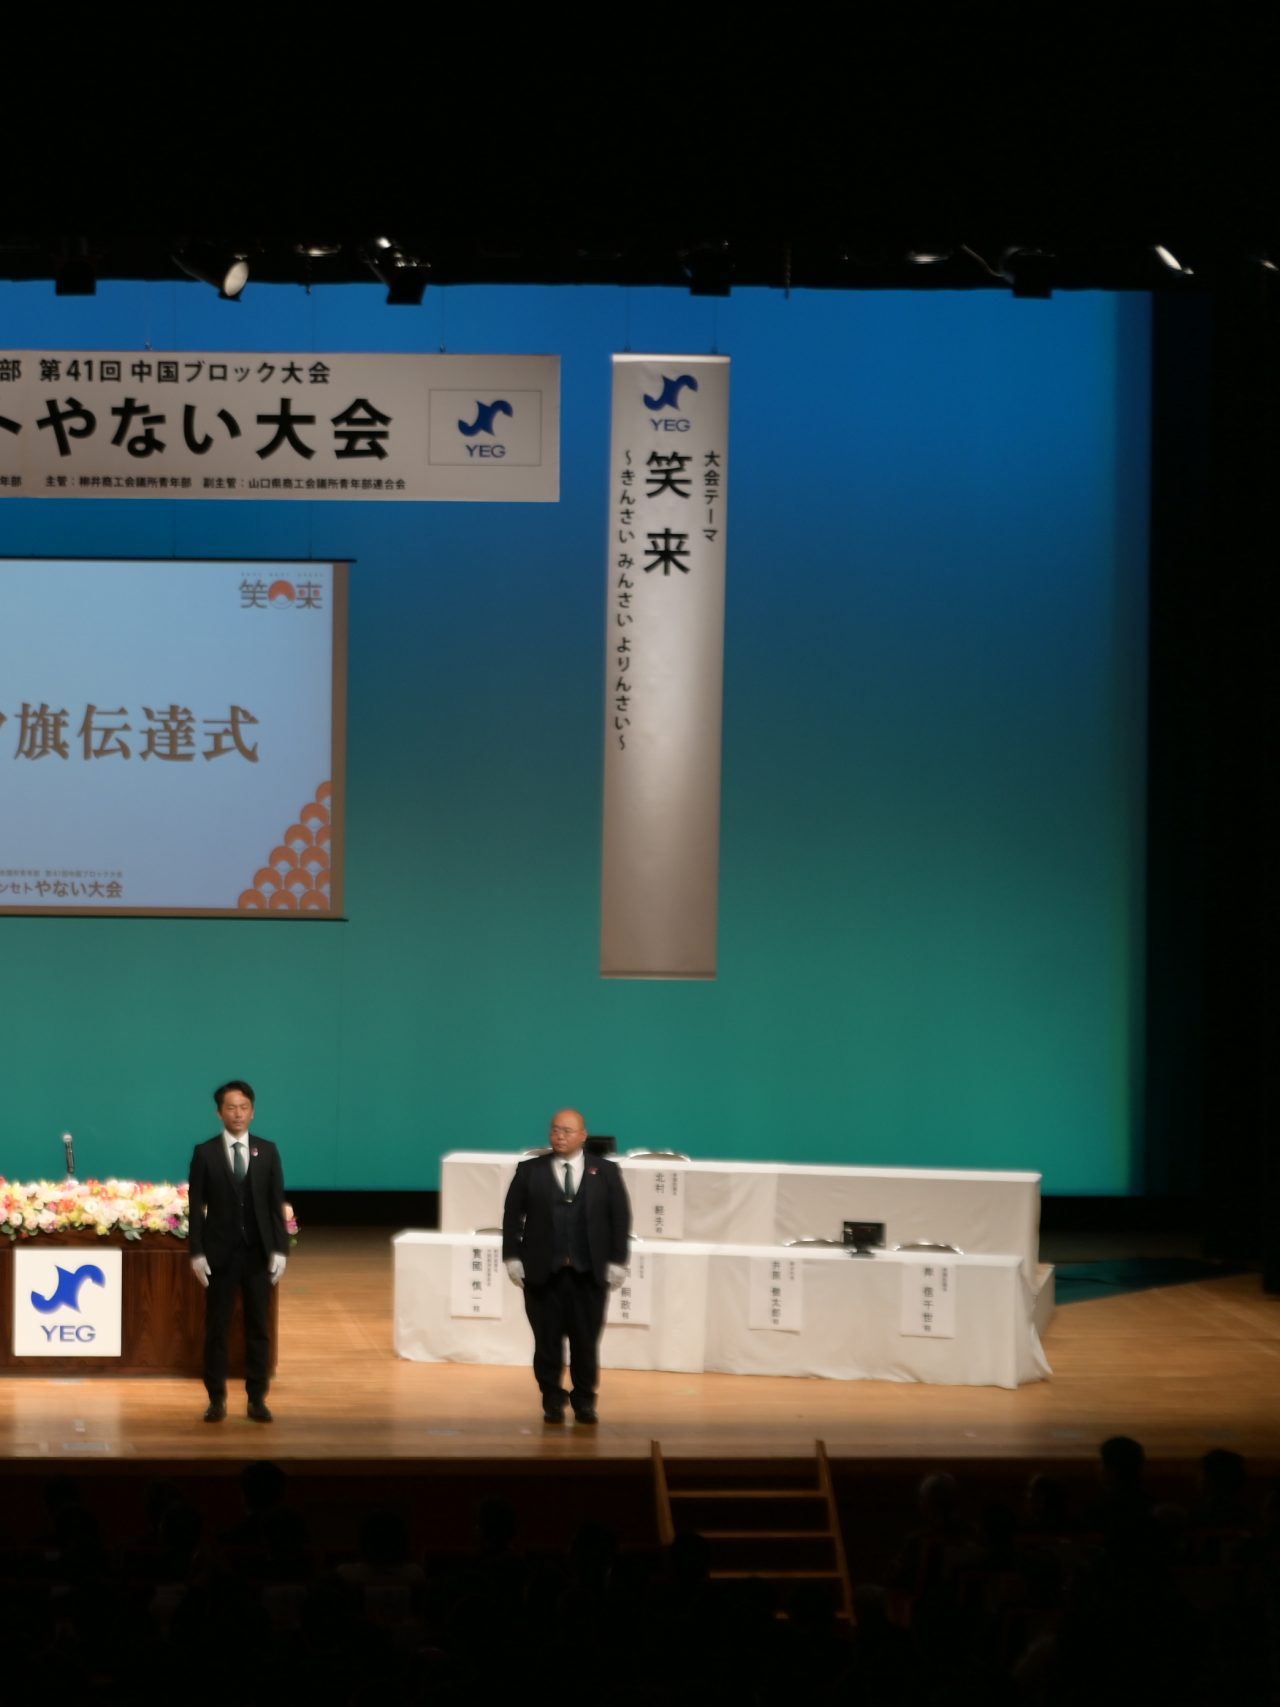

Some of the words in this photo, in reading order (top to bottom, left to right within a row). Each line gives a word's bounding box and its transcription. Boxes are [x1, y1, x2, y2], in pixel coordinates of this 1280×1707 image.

[39, 359, 122, 383] 第41回
[131, 360, 331, 384] 中国ブロック大会
[650, 418, 691, 432] YEG
[465, 444, 507, 458] YEG
[702, 450, 720, 542] 大会テーマ
[40, 1325, 96, 1343] YEG
